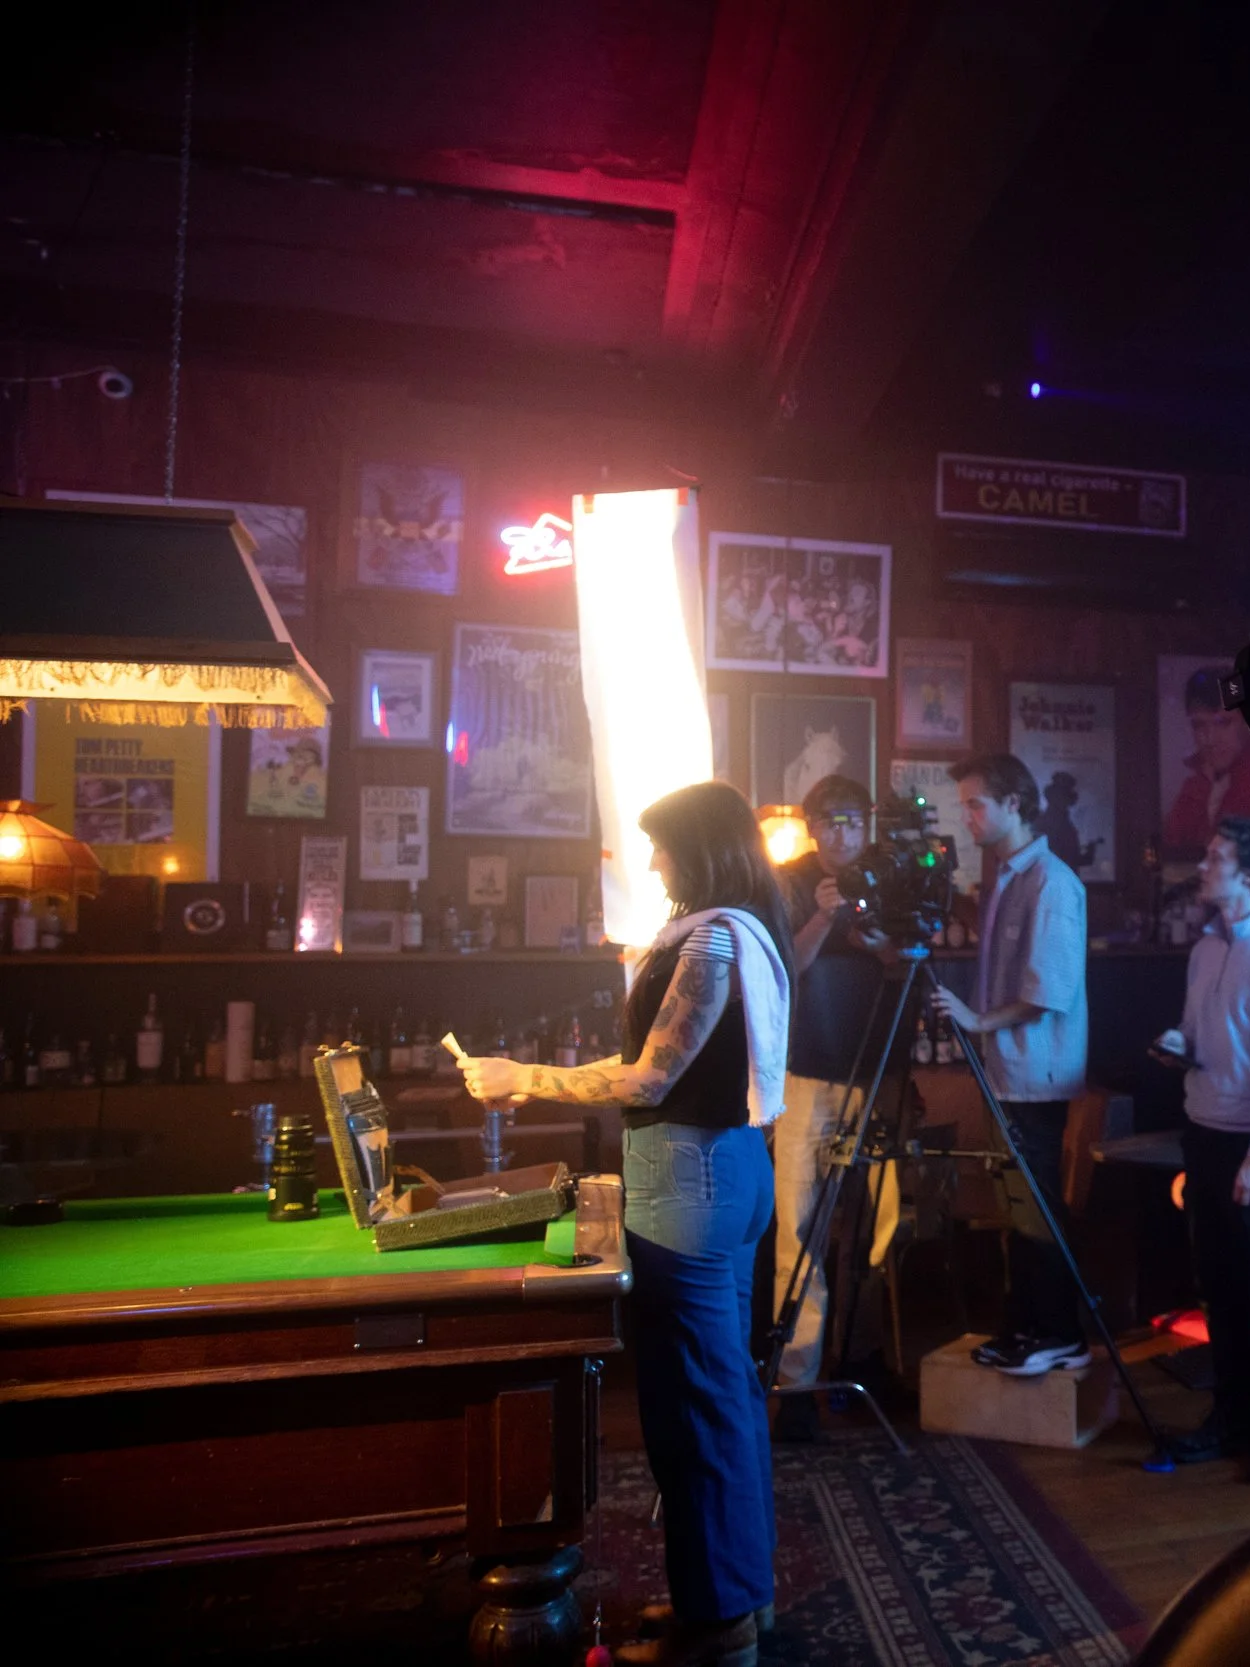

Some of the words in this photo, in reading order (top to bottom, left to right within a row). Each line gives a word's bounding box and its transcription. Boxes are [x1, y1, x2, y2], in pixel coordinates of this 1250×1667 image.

[954, 463, 995, 482] Have
[998, 471, 1010, 482] a
[1014, 470, 1047, 486] real
[977, 483, 1099, 517] CAMEL
[1018, 696, 1097, 715] Johnnie
[1021, 716, 1094, 732] Walker
